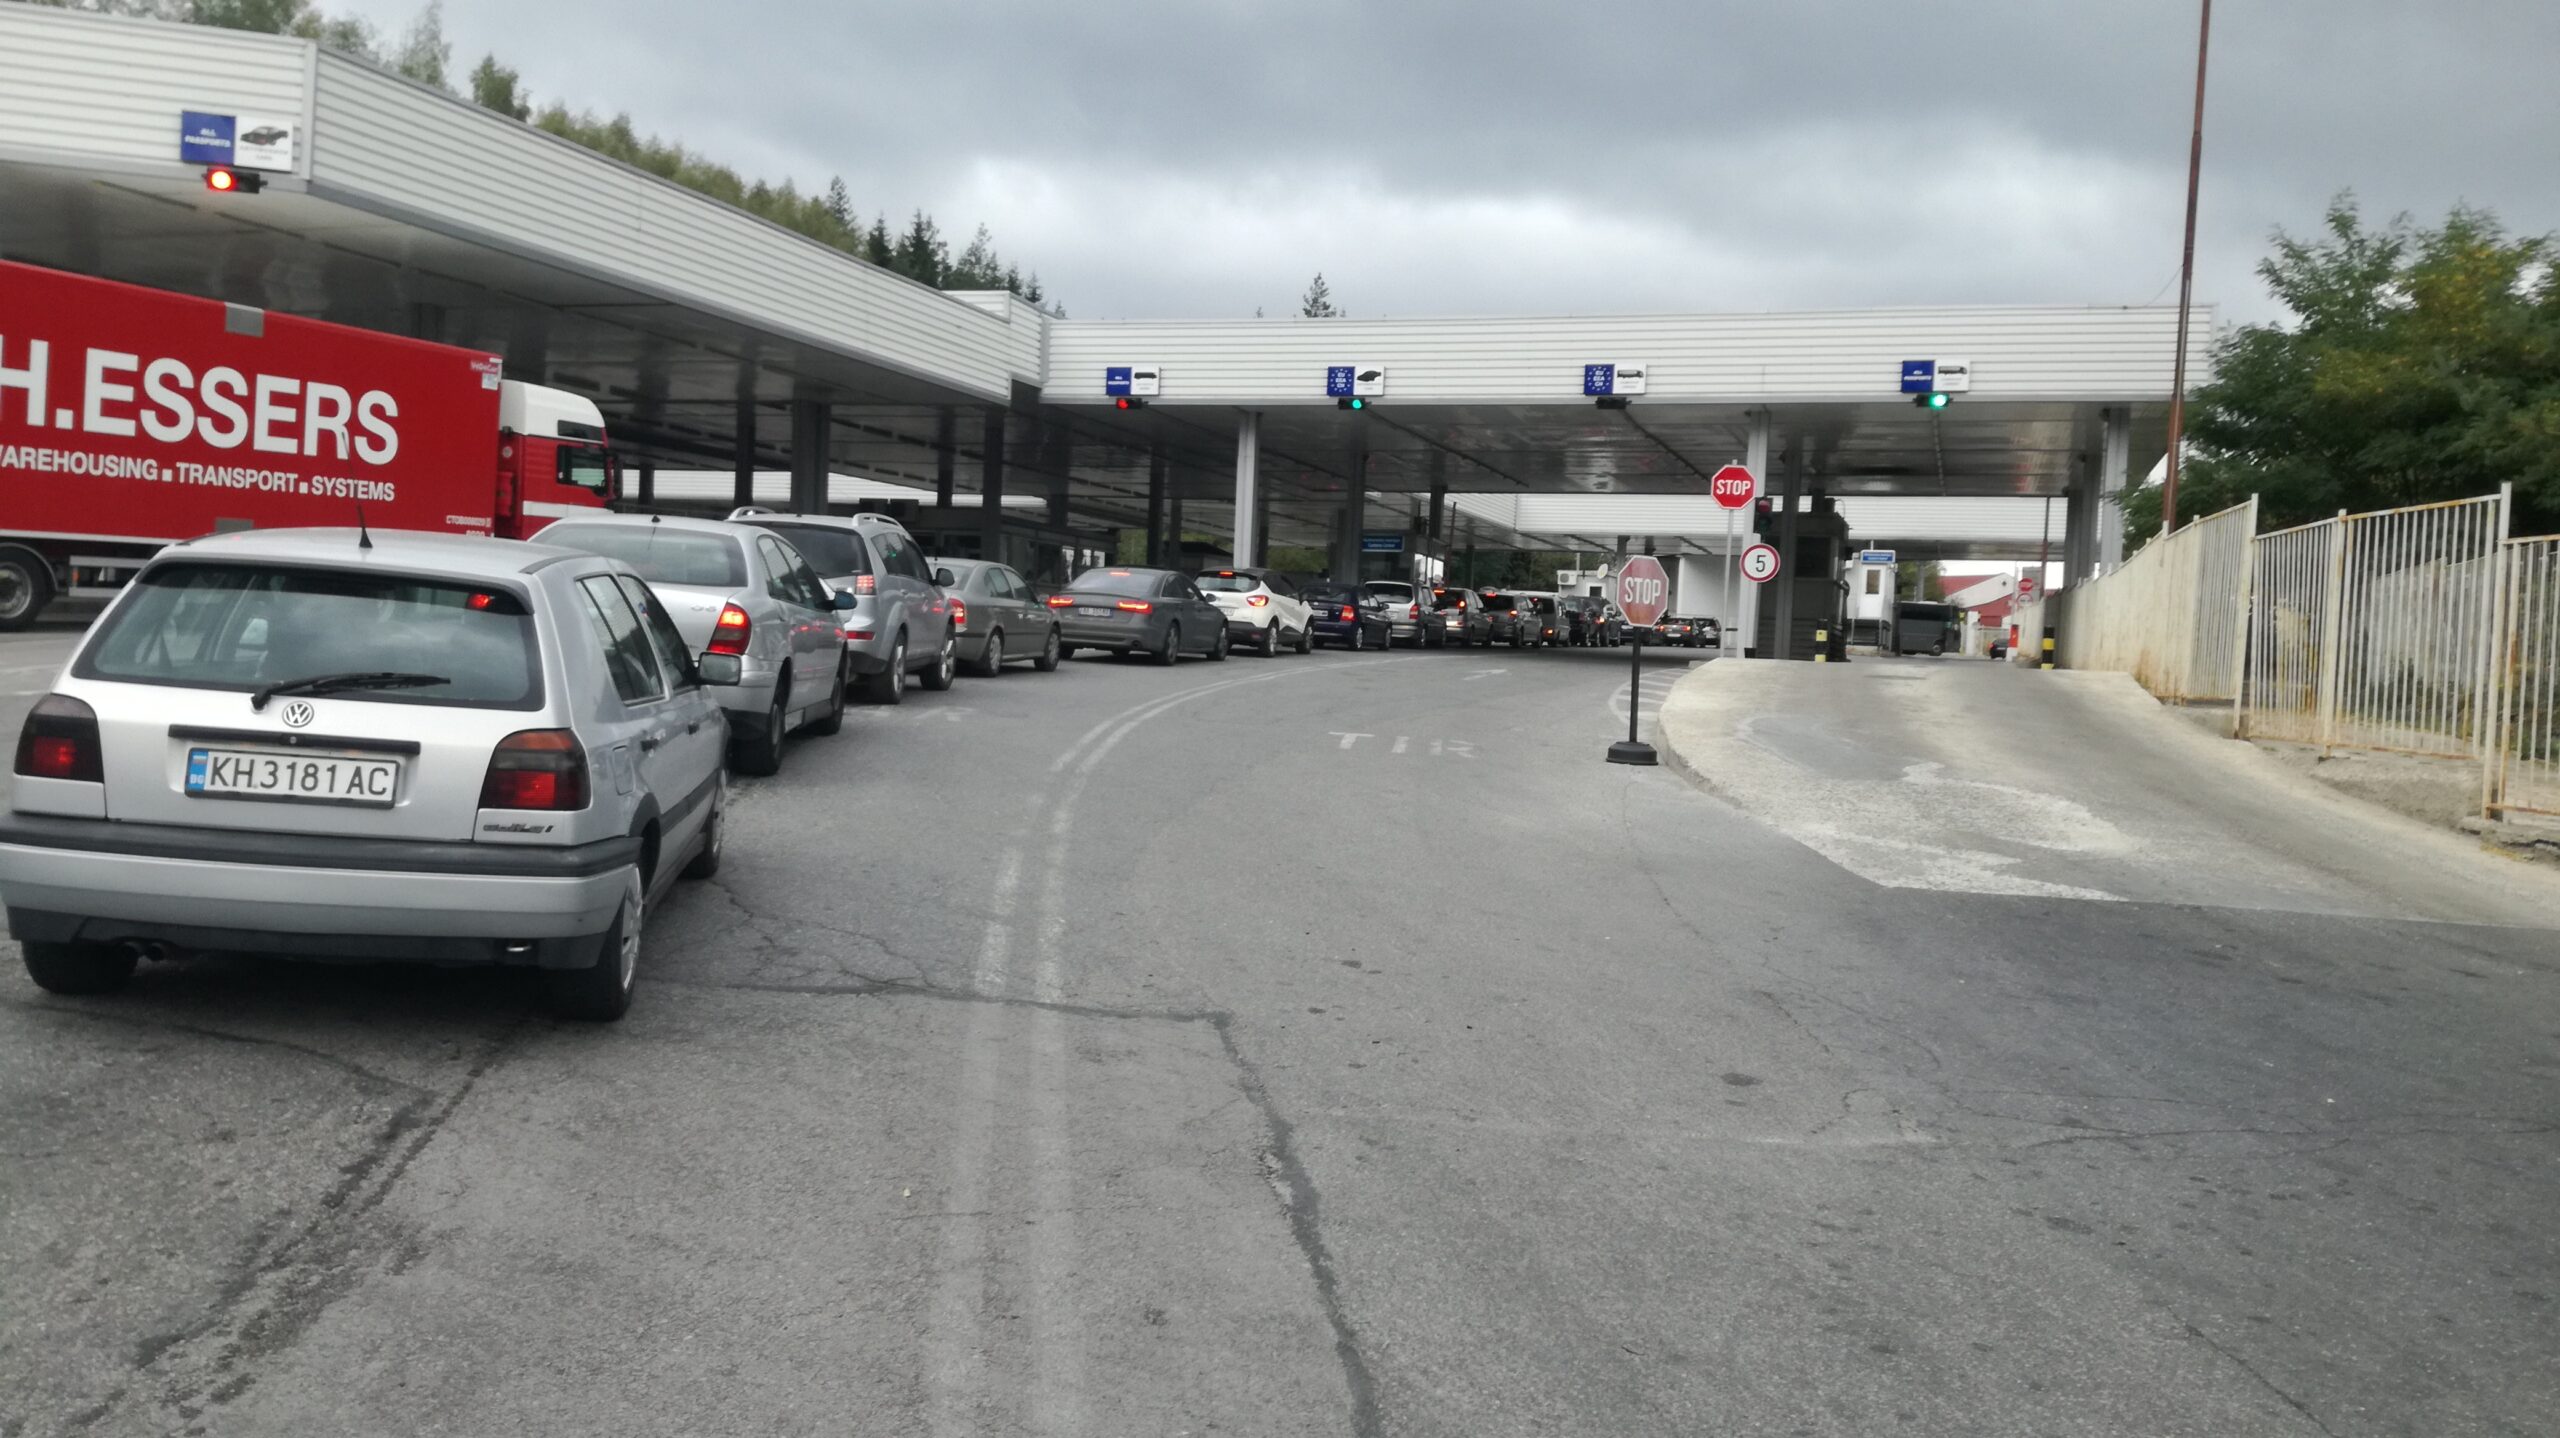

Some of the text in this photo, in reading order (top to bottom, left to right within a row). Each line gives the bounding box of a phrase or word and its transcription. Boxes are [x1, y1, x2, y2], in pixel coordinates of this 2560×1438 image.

[0, 444, 395, 502] AREHOUSING TRANSPORT SYSTEMS
[1716, 479, 1751, 496] STOP
[1755, 554, 1766, 573] 5
[1625, 577, 1661, 606] STOP
[189, 774, 205, 785] BG
